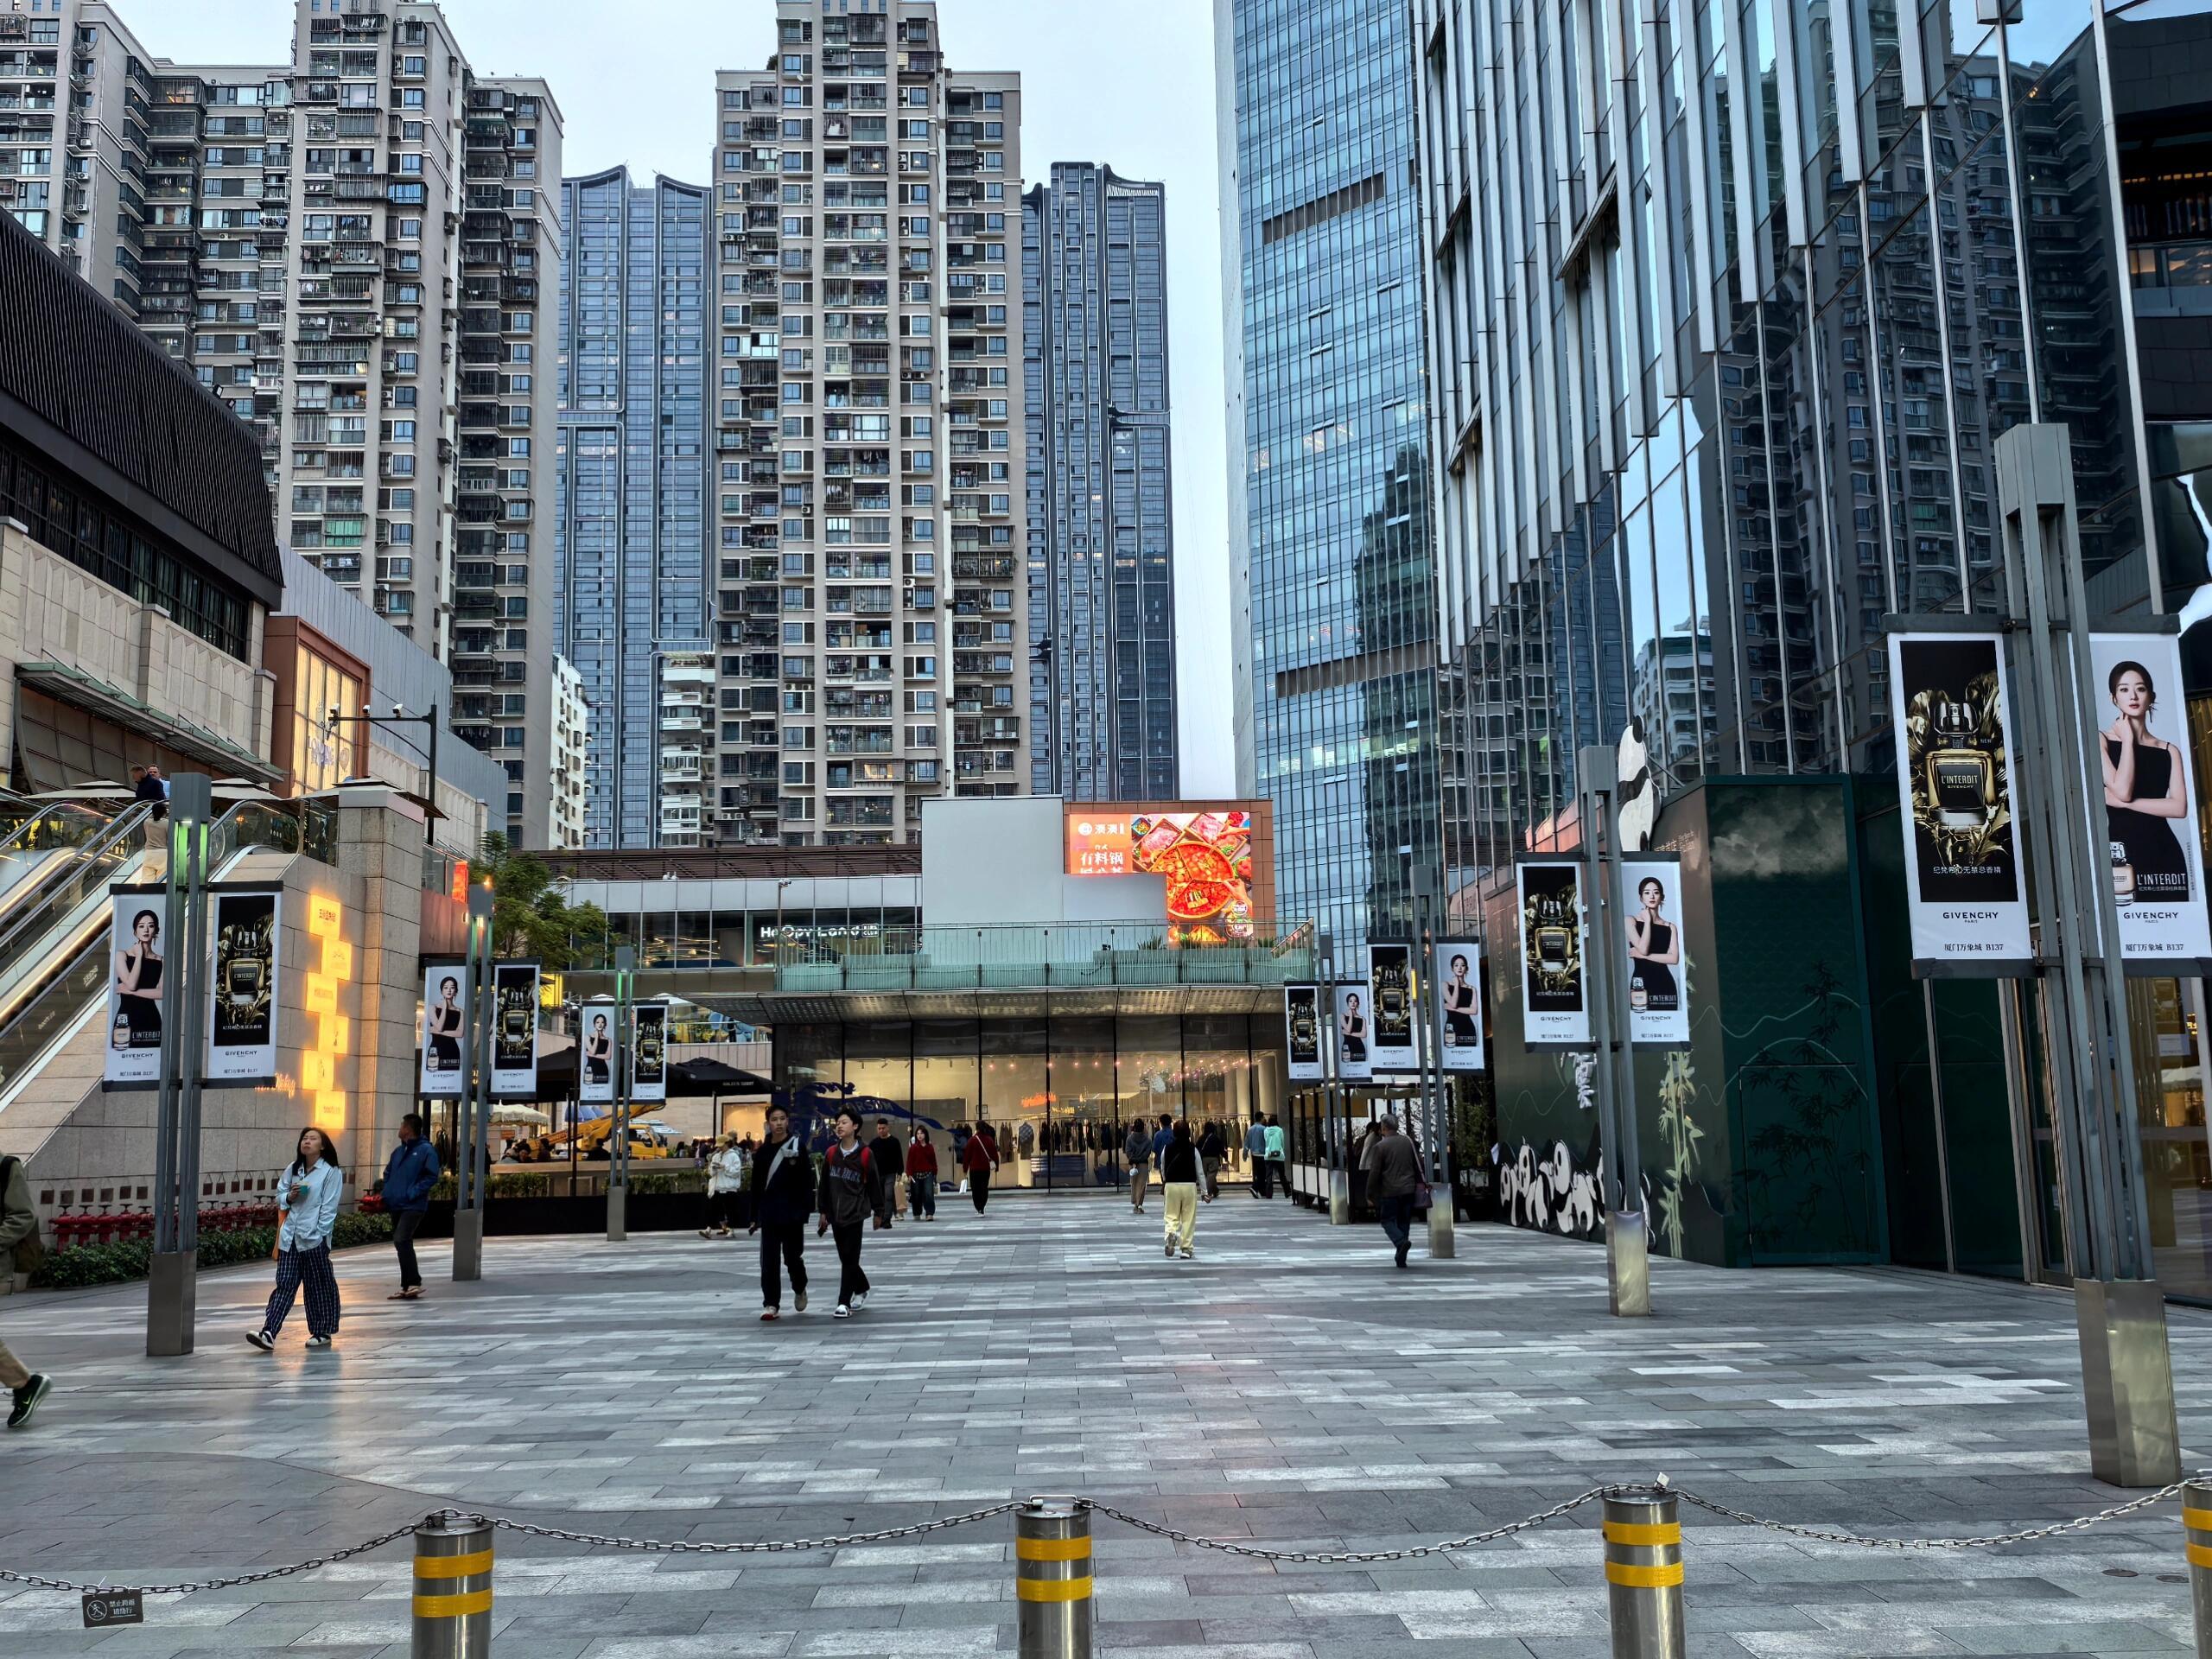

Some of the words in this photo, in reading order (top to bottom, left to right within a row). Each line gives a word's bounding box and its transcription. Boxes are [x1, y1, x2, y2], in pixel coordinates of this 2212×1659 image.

[1941, 775, 1978, 785] L'INTERDIT
[2137, 874, 2186, 885] L'INTERDIT
[1944, 944, 1982, 952] 厦门万象城
